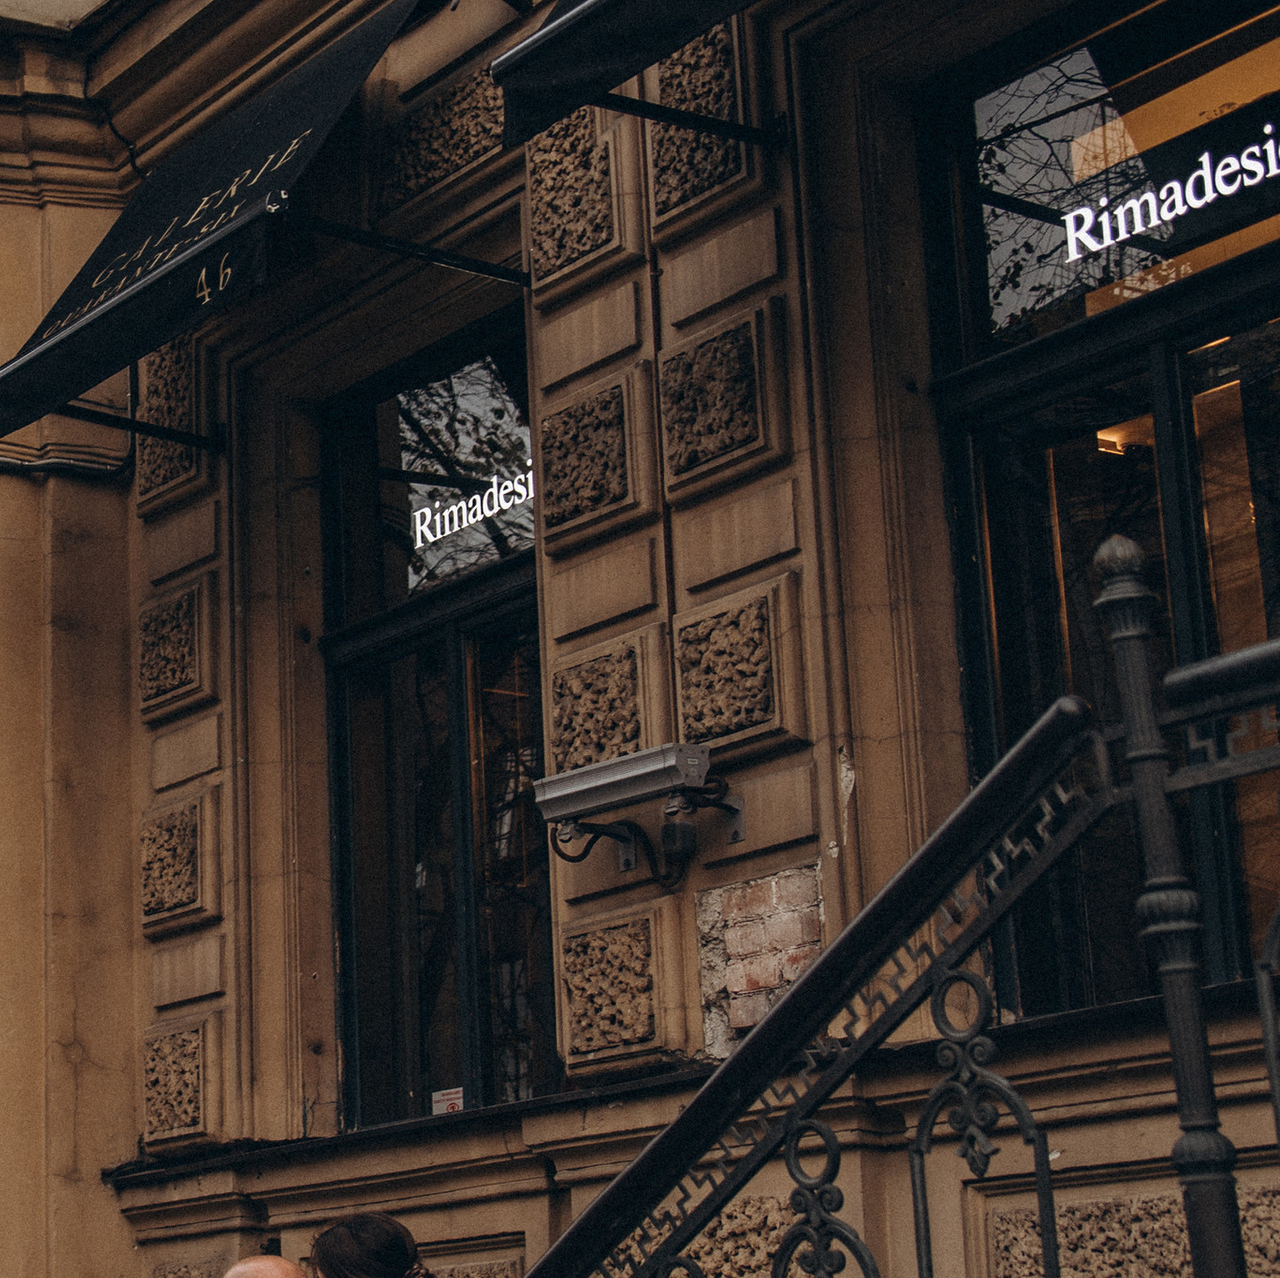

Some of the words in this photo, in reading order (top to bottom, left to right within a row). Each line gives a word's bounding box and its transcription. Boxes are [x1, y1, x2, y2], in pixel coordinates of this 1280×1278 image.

[91, 128, 313, 289] GALERIE
[1060, 122, 1280, 264] Rimadesi
[195, 252, 233, 305] 46
